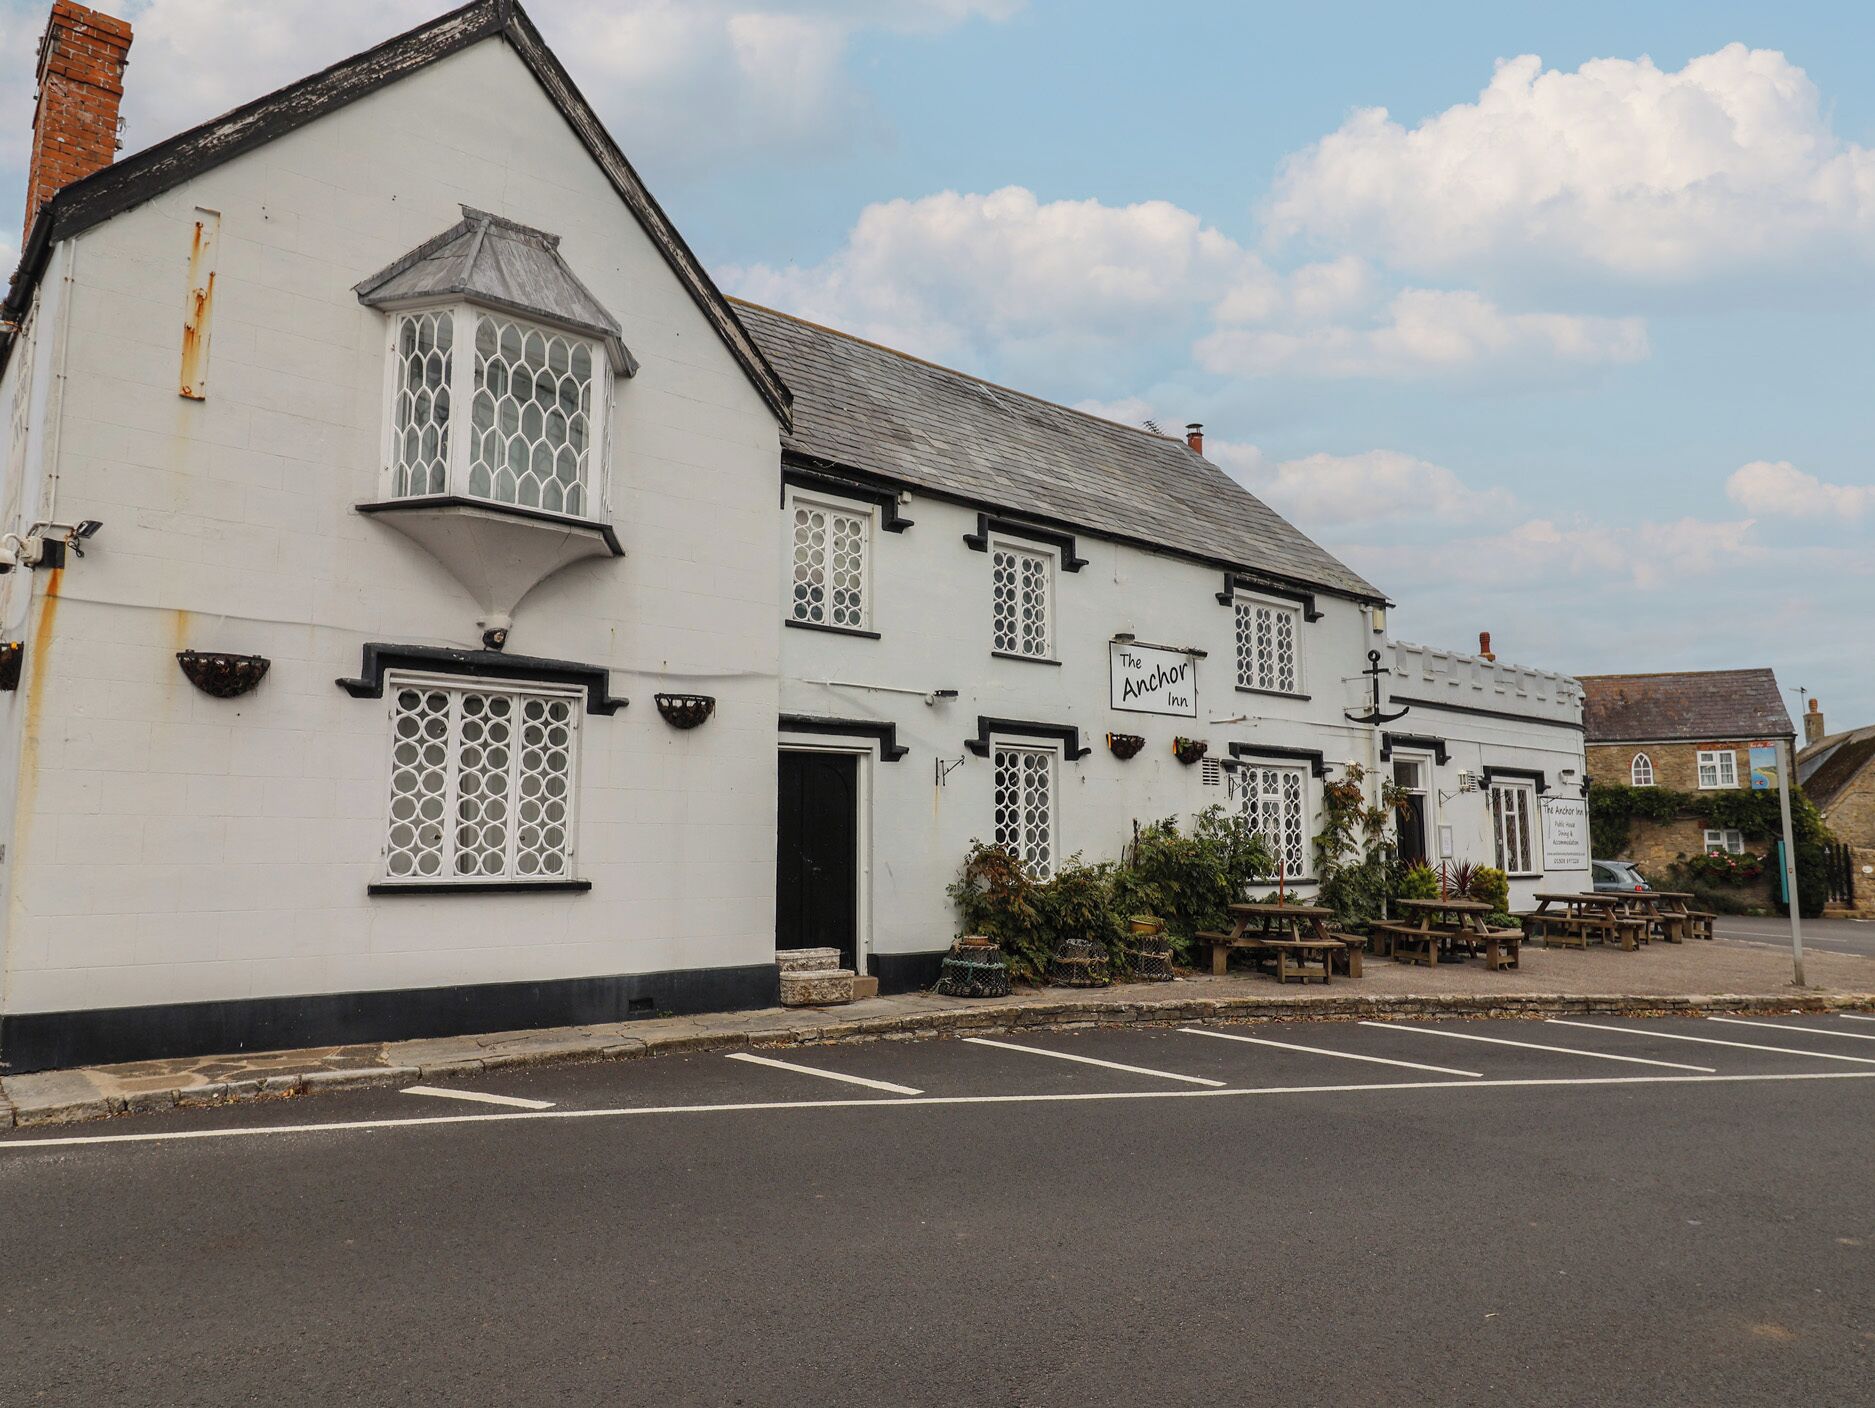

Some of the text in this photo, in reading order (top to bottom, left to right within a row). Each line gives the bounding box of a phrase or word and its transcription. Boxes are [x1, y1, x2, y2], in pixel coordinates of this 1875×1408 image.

[1119, 653, 1142, 669] The
[1122, 662, 1188, 702] Anchor
[1168, 692, 1188, 708] Inn
[1543, 804, 1584, 816] The Anchor Inn
